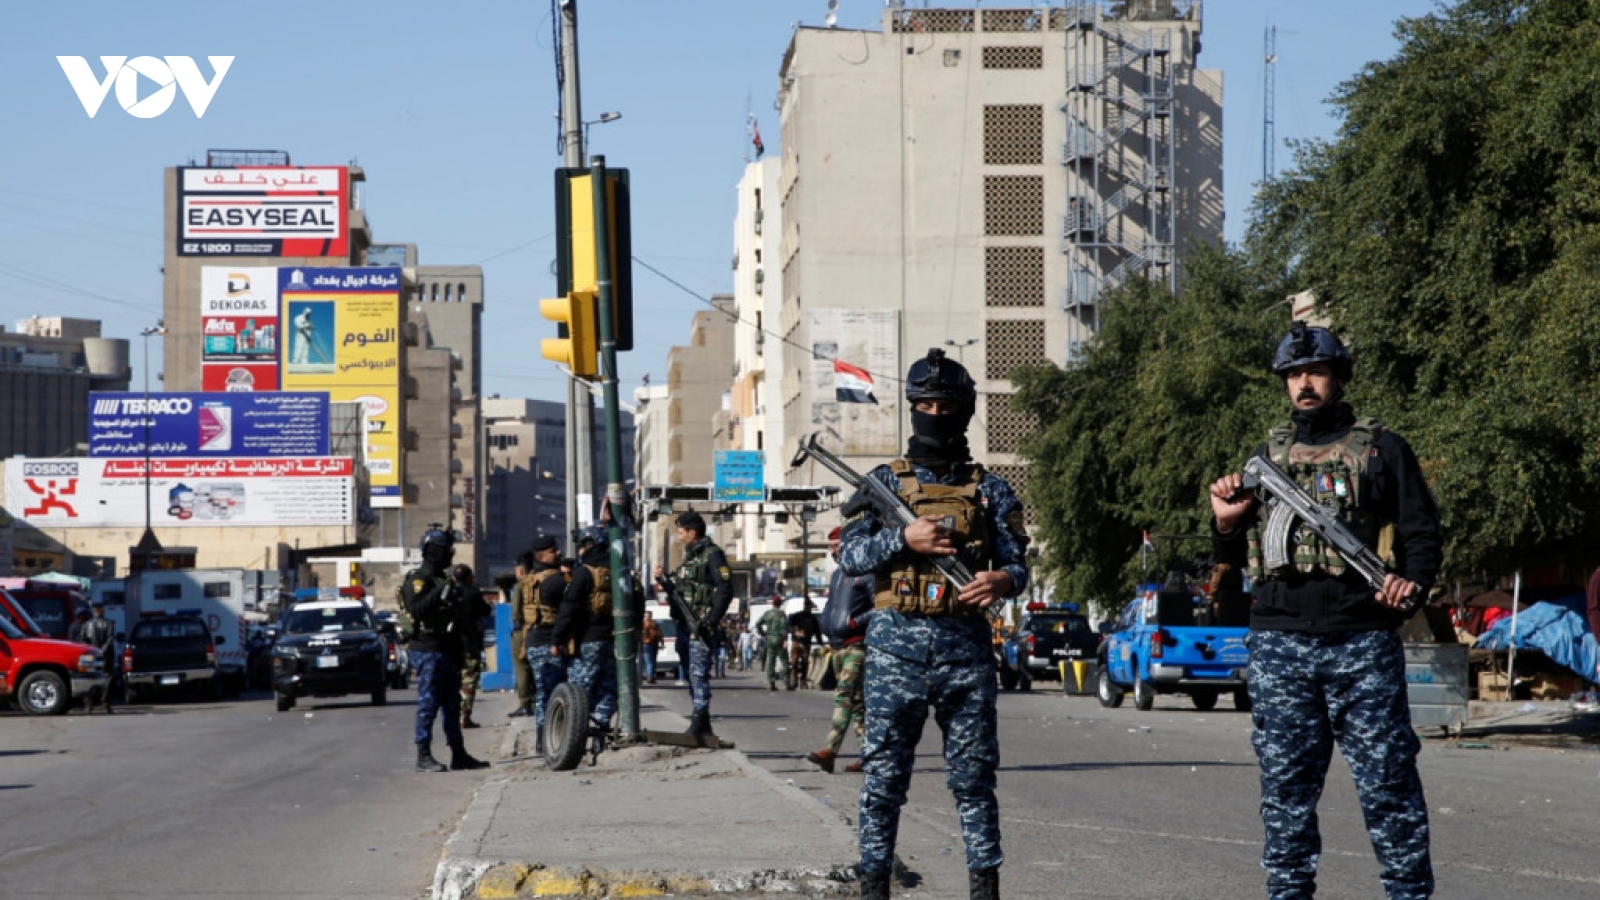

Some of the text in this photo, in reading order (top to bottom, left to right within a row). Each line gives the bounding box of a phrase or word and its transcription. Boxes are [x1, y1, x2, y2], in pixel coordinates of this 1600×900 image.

[204, 171, 319, 191] علي خلف
[188, 208, 335, 226] EASYSEAL
[183, 243, 200, 253] EZ
[313, 275, 340, 287] بغداد
[369, 273, 398, 287] شركة
[209, 299, 267, 310] DEKORAS
[342, 328, 396, 347] الفوم
[121, 398, 193, 415] TERRACO
[25, 464, 77, 475] FOSROC
[228, 459, 295, 476] البريطانية
[296, 459, 345, 474] الشركة
[308, 638, 340, 647] POLICE
